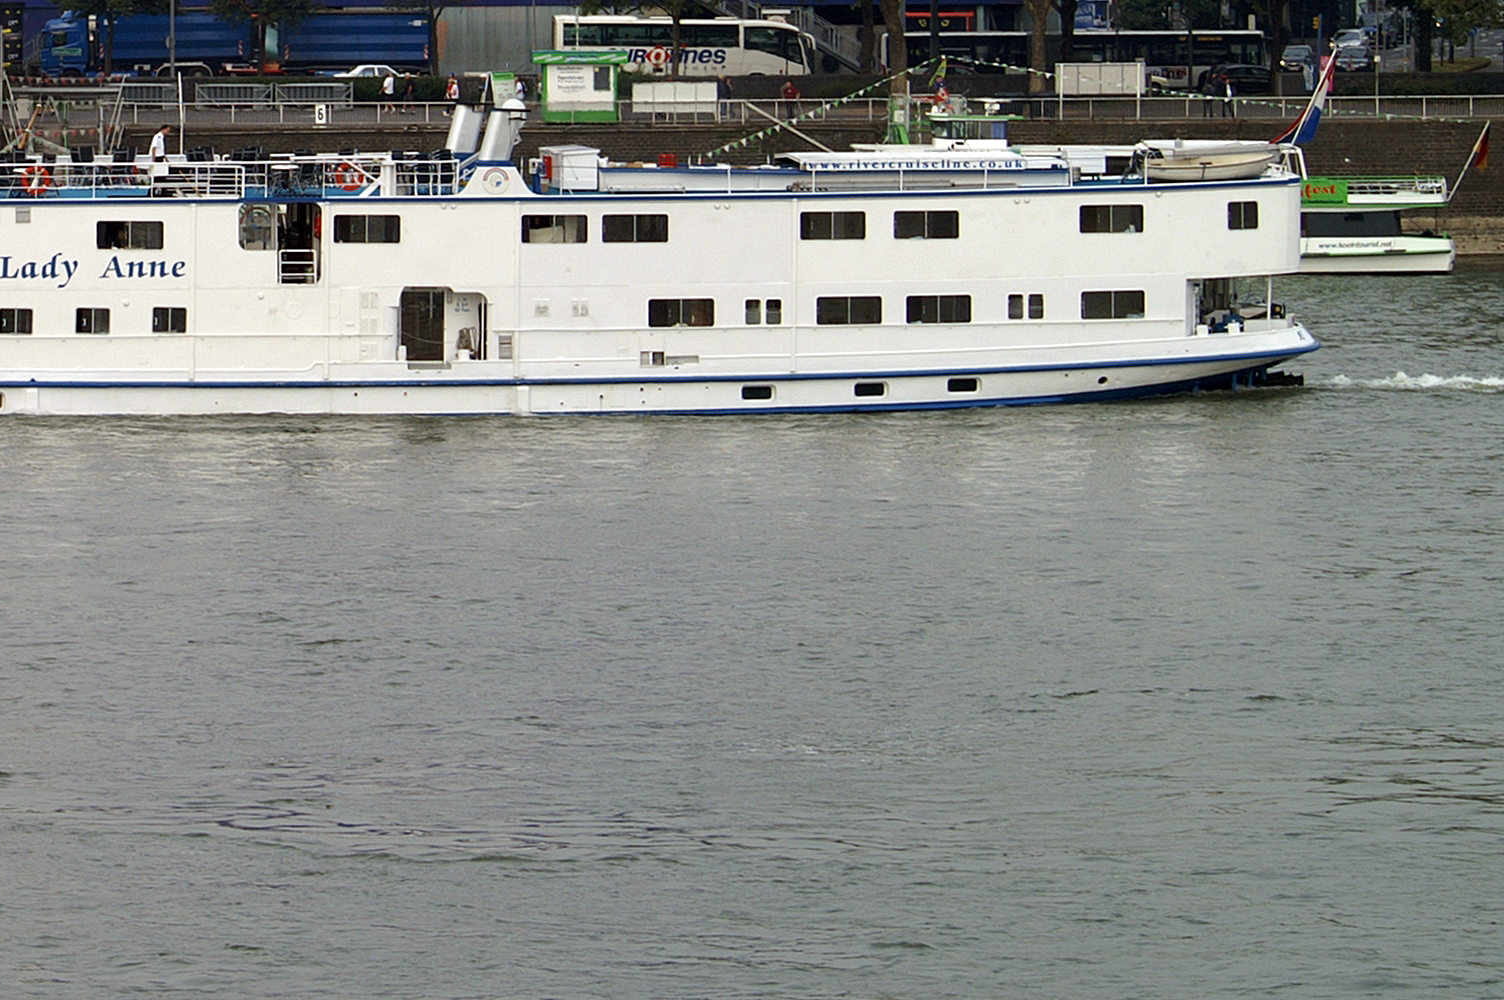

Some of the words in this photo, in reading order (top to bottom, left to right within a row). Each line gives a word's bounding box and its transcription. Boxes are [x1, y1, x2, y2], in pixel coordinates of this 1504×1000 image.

[317, 107, 324, 121] 6
[1300, 183, 1337, 199] fest
[98, 255, 186, 279] Anne
